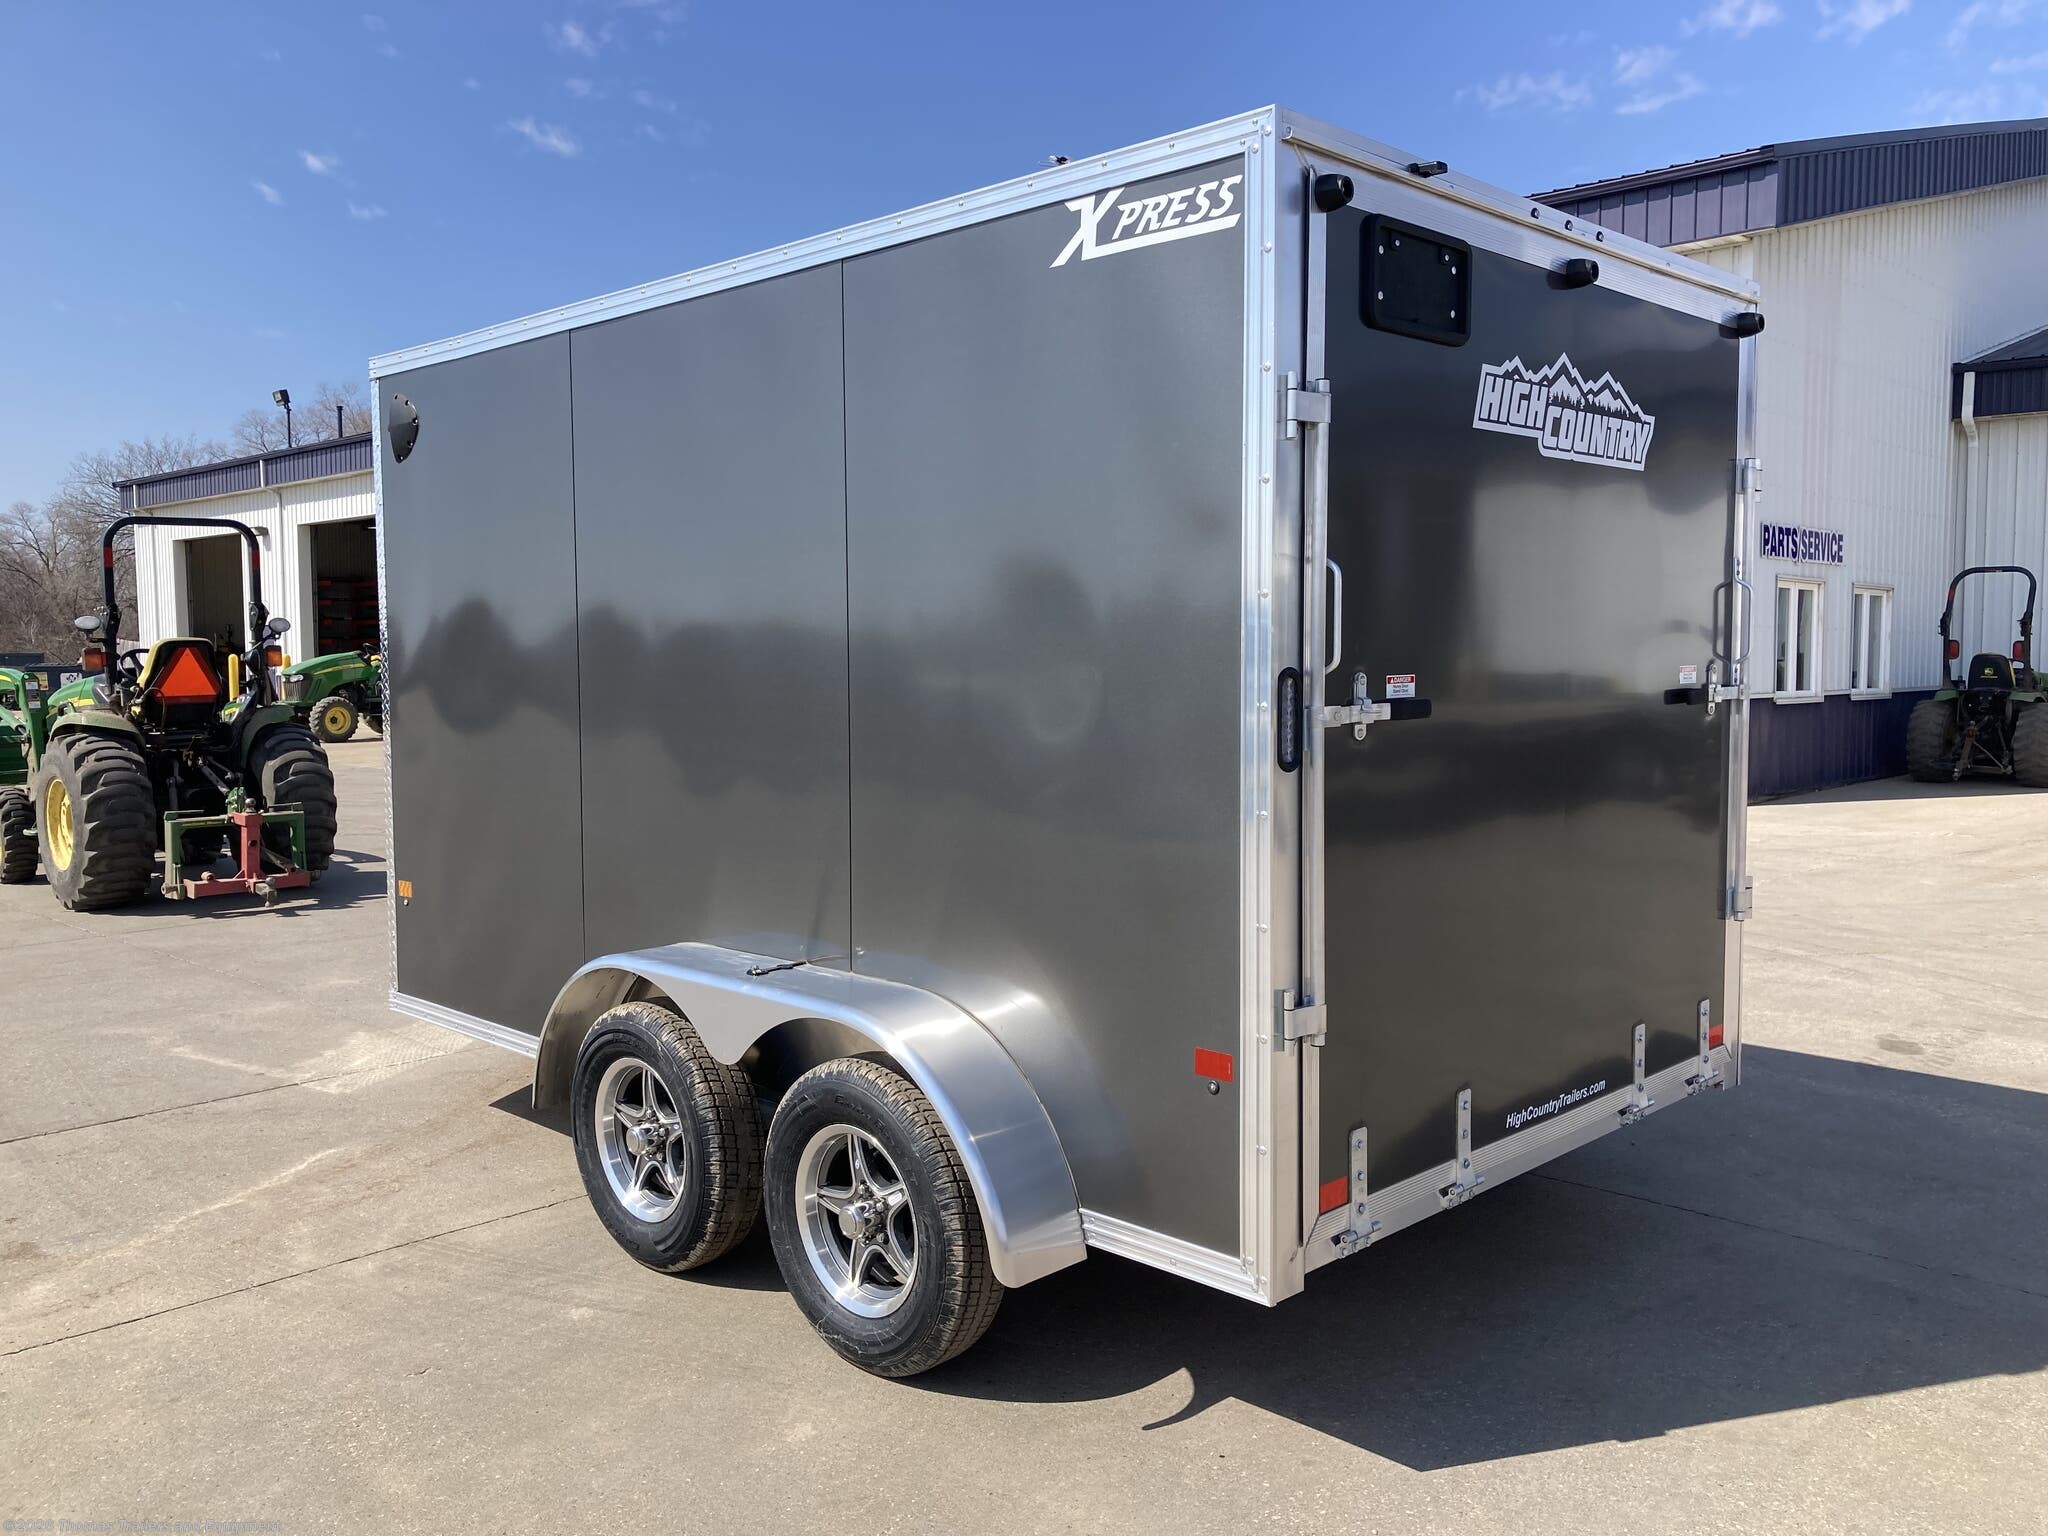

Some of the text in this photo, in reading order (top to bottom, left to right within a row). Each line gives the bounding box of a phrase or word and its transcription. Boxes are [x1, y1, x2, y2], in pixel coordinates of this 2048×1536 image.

[1050, 175, 1243, 268] XPRESS
[1479, 375, 1549, 428] HIGH
[1543, 405, 1650, 463] COUNTRY
[1505, 1079, 1606, 1129] HighCountryTrailers.com
